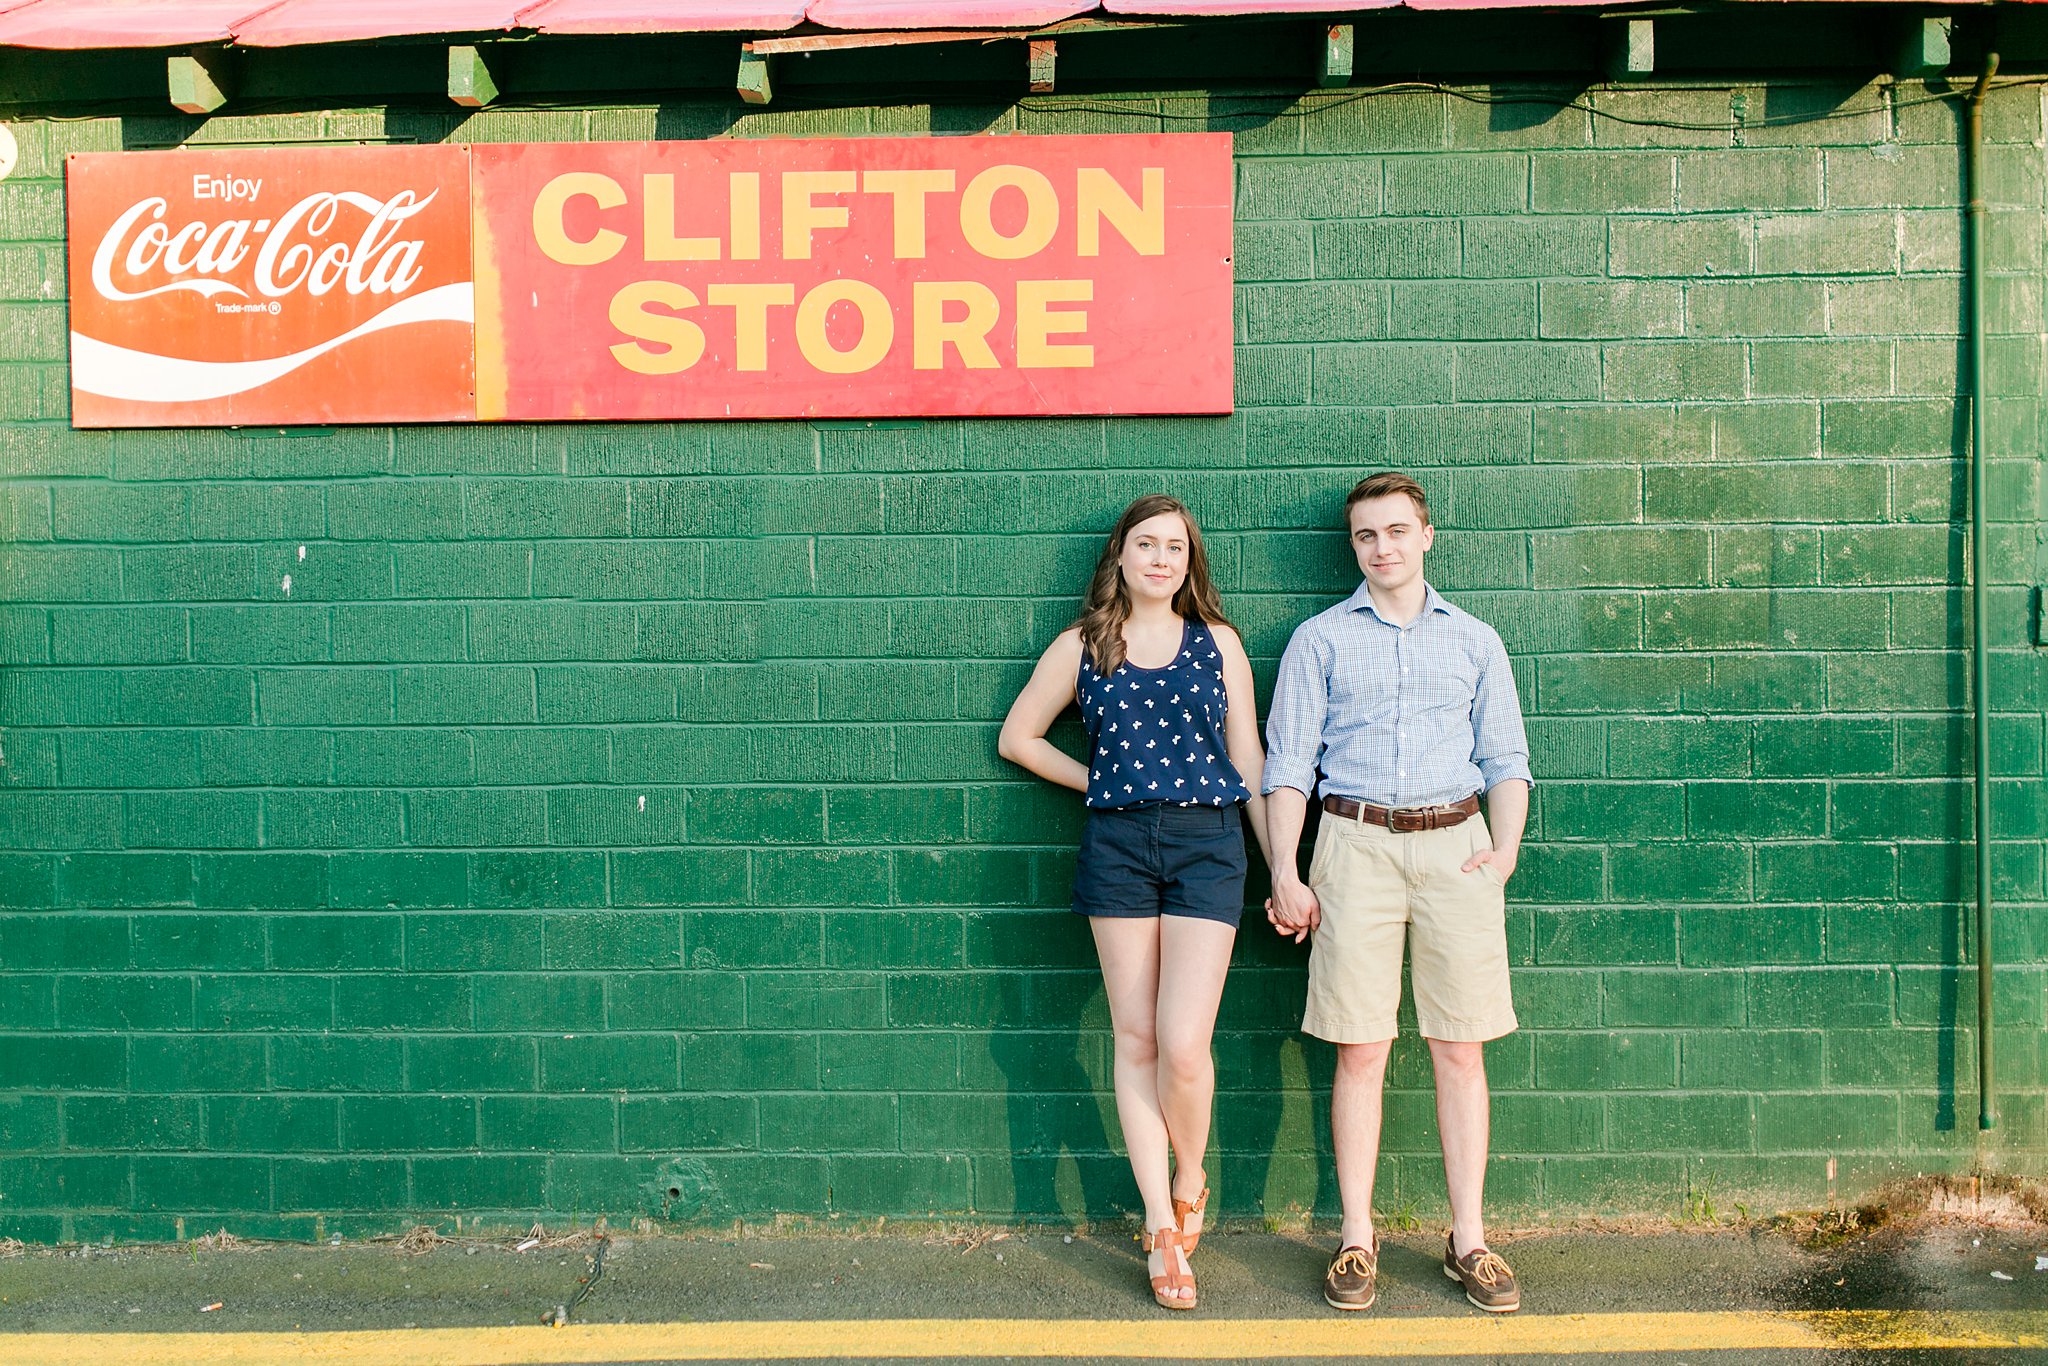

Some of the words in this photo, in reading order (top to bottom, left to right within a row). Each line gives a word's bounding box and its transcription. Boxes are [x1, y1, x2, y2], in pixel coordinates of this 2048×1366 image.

[193, 173, 263, 202] Enjoy
[532, 164, 1166, 266] CLIFTON
[92, 187, 440, 302] Coca-Cola
[608, 279, 1095, 375] STORE
